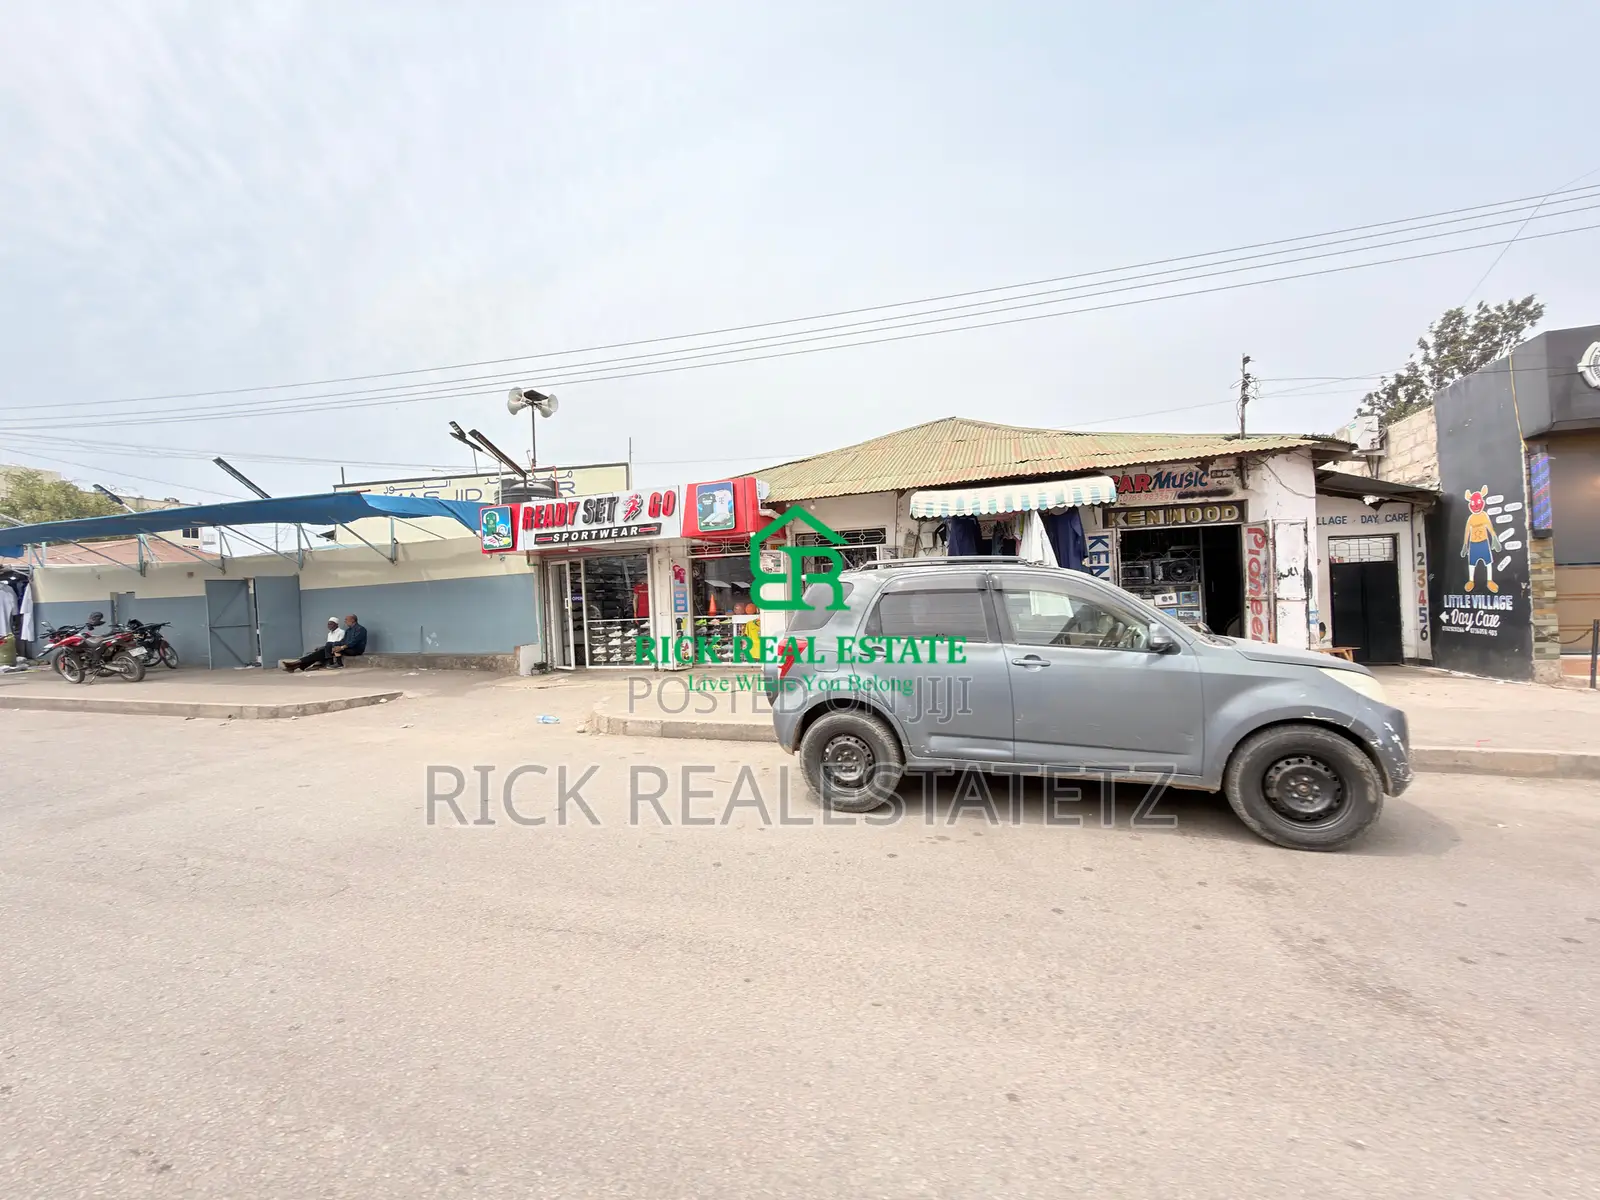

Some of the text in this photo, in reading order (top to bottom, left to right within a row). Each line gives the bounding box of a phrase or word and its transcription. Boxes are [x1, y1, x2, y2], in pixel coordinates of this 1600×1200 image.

[522, 490, 676, 531] READY SET GO
[1360, 514, 1379, 524] DAY
[1384, 512, 1409, 523] CARE
[553, 526, 640, 543] SPORTWEAR
[1416, 533, 1422, 548] 1
[1417, 552, 1425, 566] 2
[1417, 569, 1426, 588] 3
[1418, 590, 1427, 606] 4
[1443, 594, 1513, 611] LITTLE VILLAGE
[1418, 607, 1428, 623] 5
[1451, 609, 1474, 632] Day
[1475, 610, 1501, 628] Care
[1420, 625, 1429, 641] 6
